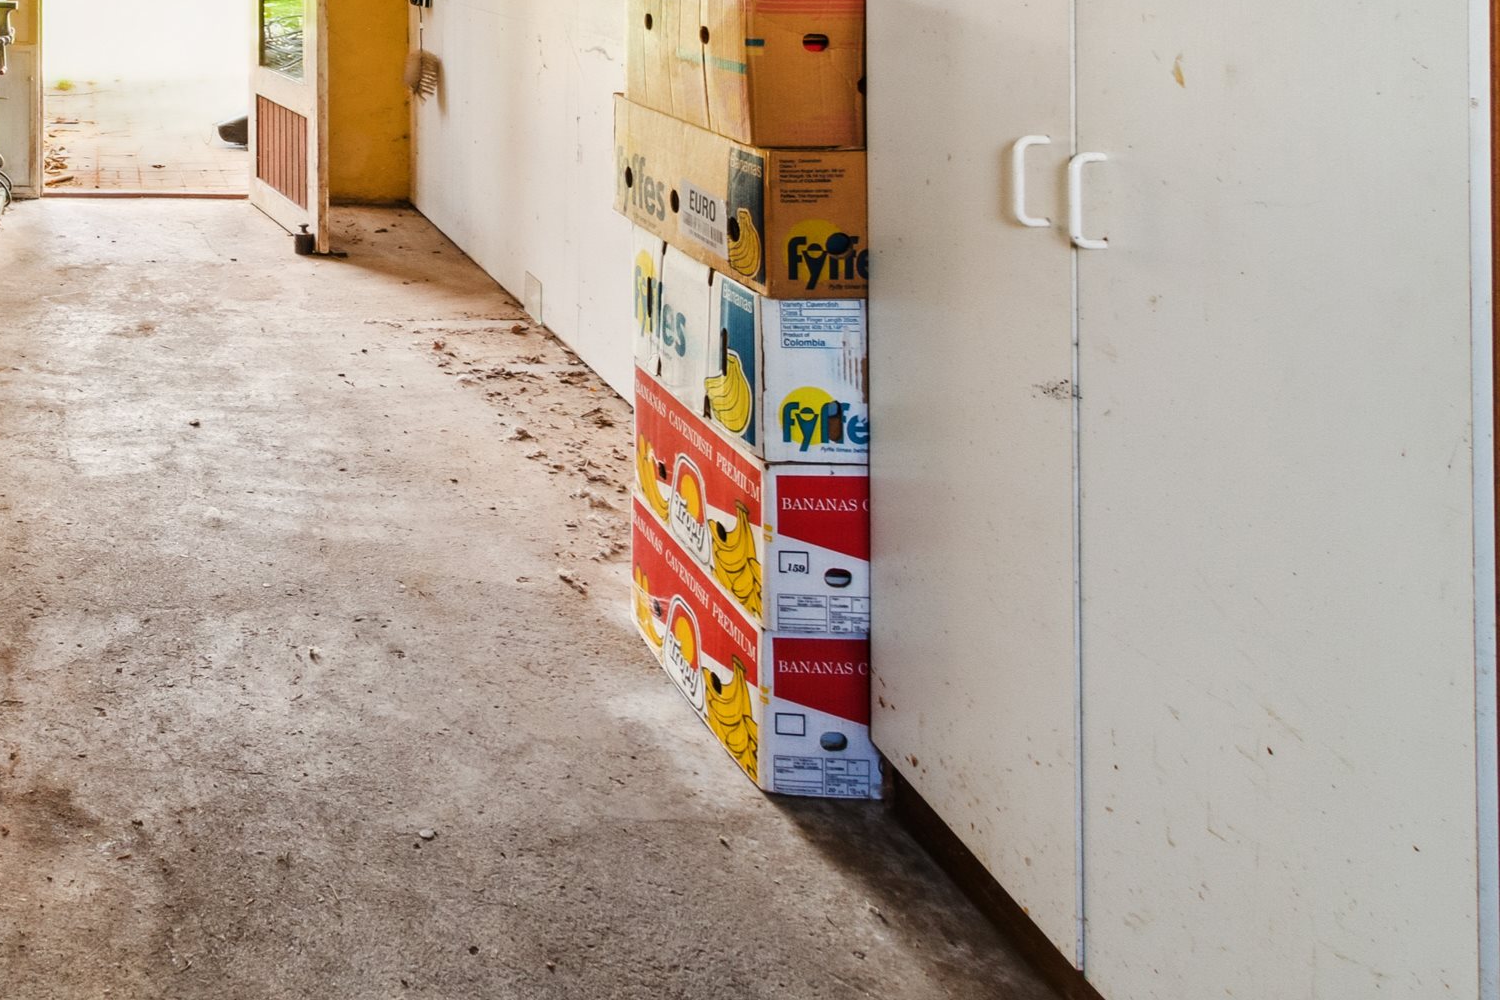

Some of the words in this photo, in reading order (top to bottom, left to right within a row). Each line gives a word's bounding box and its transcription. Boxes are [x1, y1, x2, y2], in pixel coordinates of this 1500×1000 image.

[690, 189, 716, 222] EURO
[722, 283, 753, 313] Bananas
[783, 339, 826, 347] Colombia
[635, 378, 667, 418] BANANAS
[669, 409, 713, 461] CAVENDISH
[716, 451, 760, 503] PREMIUM
[782, 401, 869, 452] fyffe
[782, 497, 859, 511] BANANAS
[675, 492, 706, 553] Tropy
[787, 563, 806, 573] 159
[665, 549, 709, 609] CAVENDISH
[712, 601, 757, 663] PREMIUM
[668, 631, 699, 697] Tropy
[778, 660, 854, 675] BANANAS
